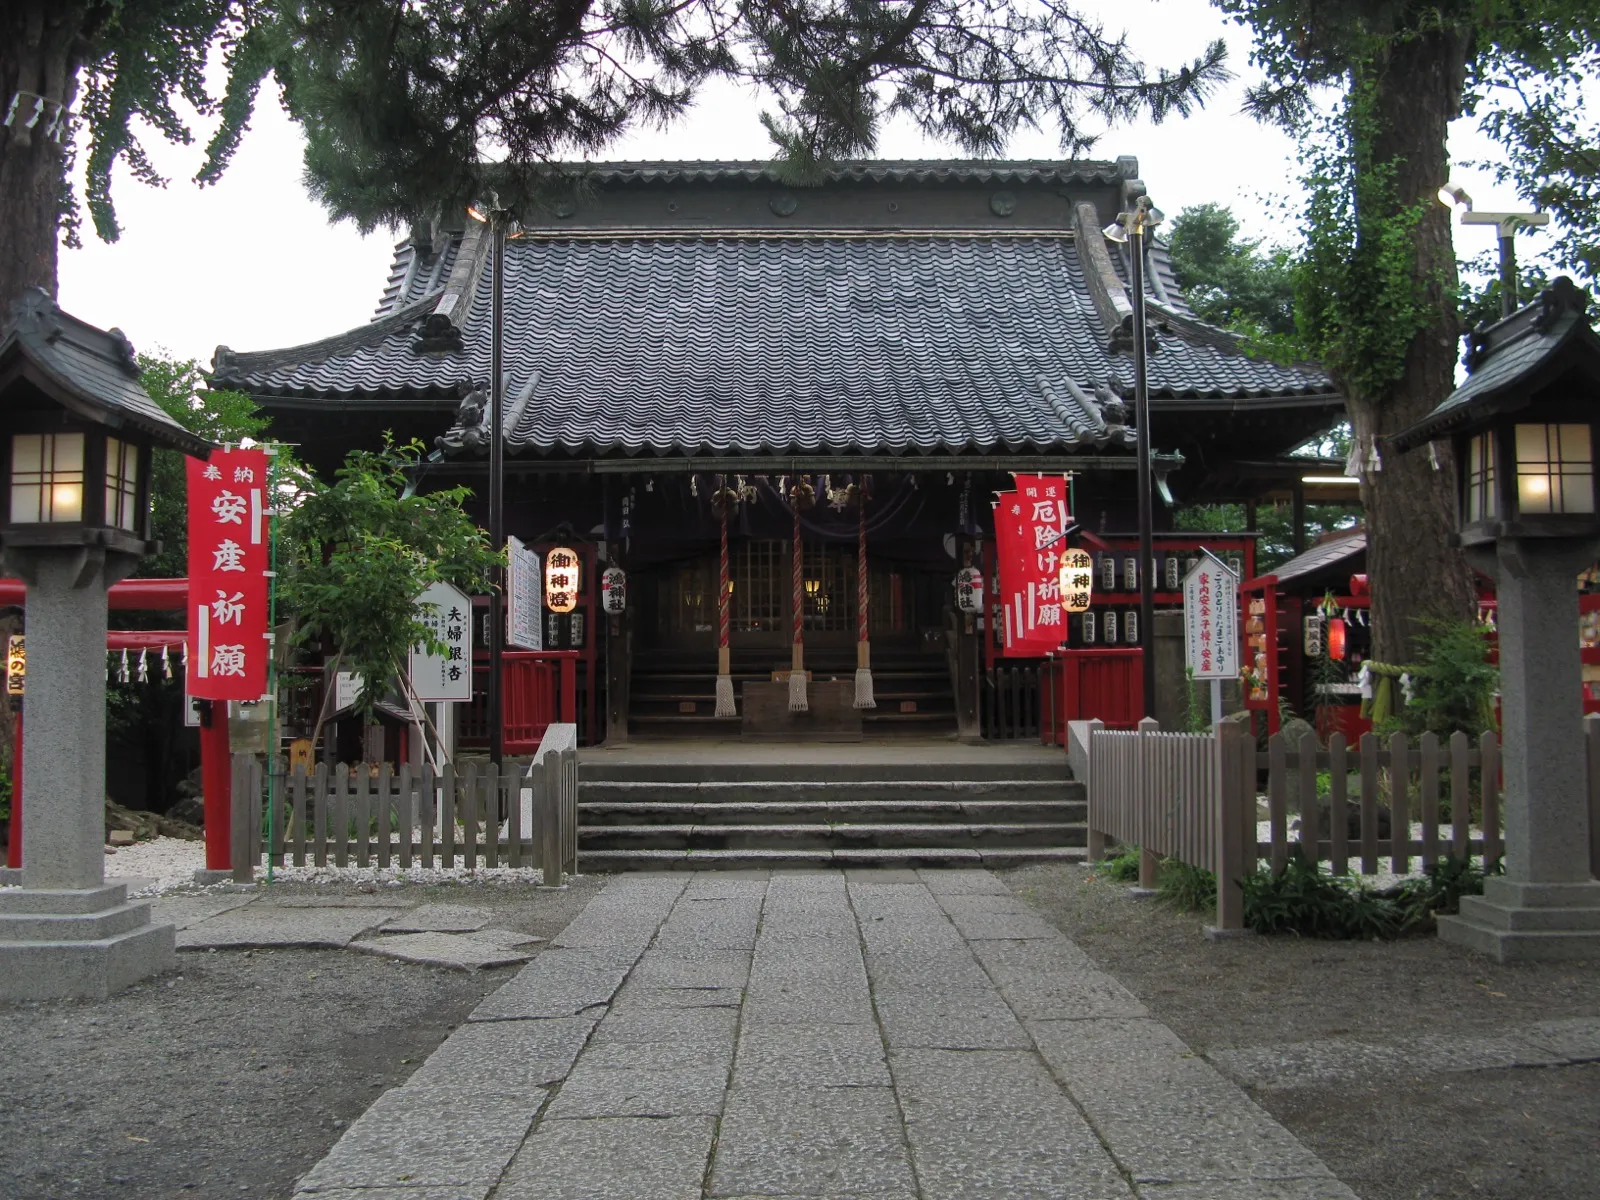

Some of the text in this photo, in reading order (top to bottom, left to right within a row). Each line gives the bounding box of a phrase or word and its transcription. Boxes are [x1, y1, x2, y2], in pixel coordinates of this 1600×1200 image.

[202, 464, 254, 483] 奉納
[211, 489, 248, 678] 安産祈願
[549, 552, 571, 608] 御神燈
[1031, 500, 1062, 626] 厄除け祈願
[1070, 553, 1091, 608] 御神燈
[608, 572, 625, 611] 鴻神社
[447, 606, 463, 682] 夫婦銀杏
